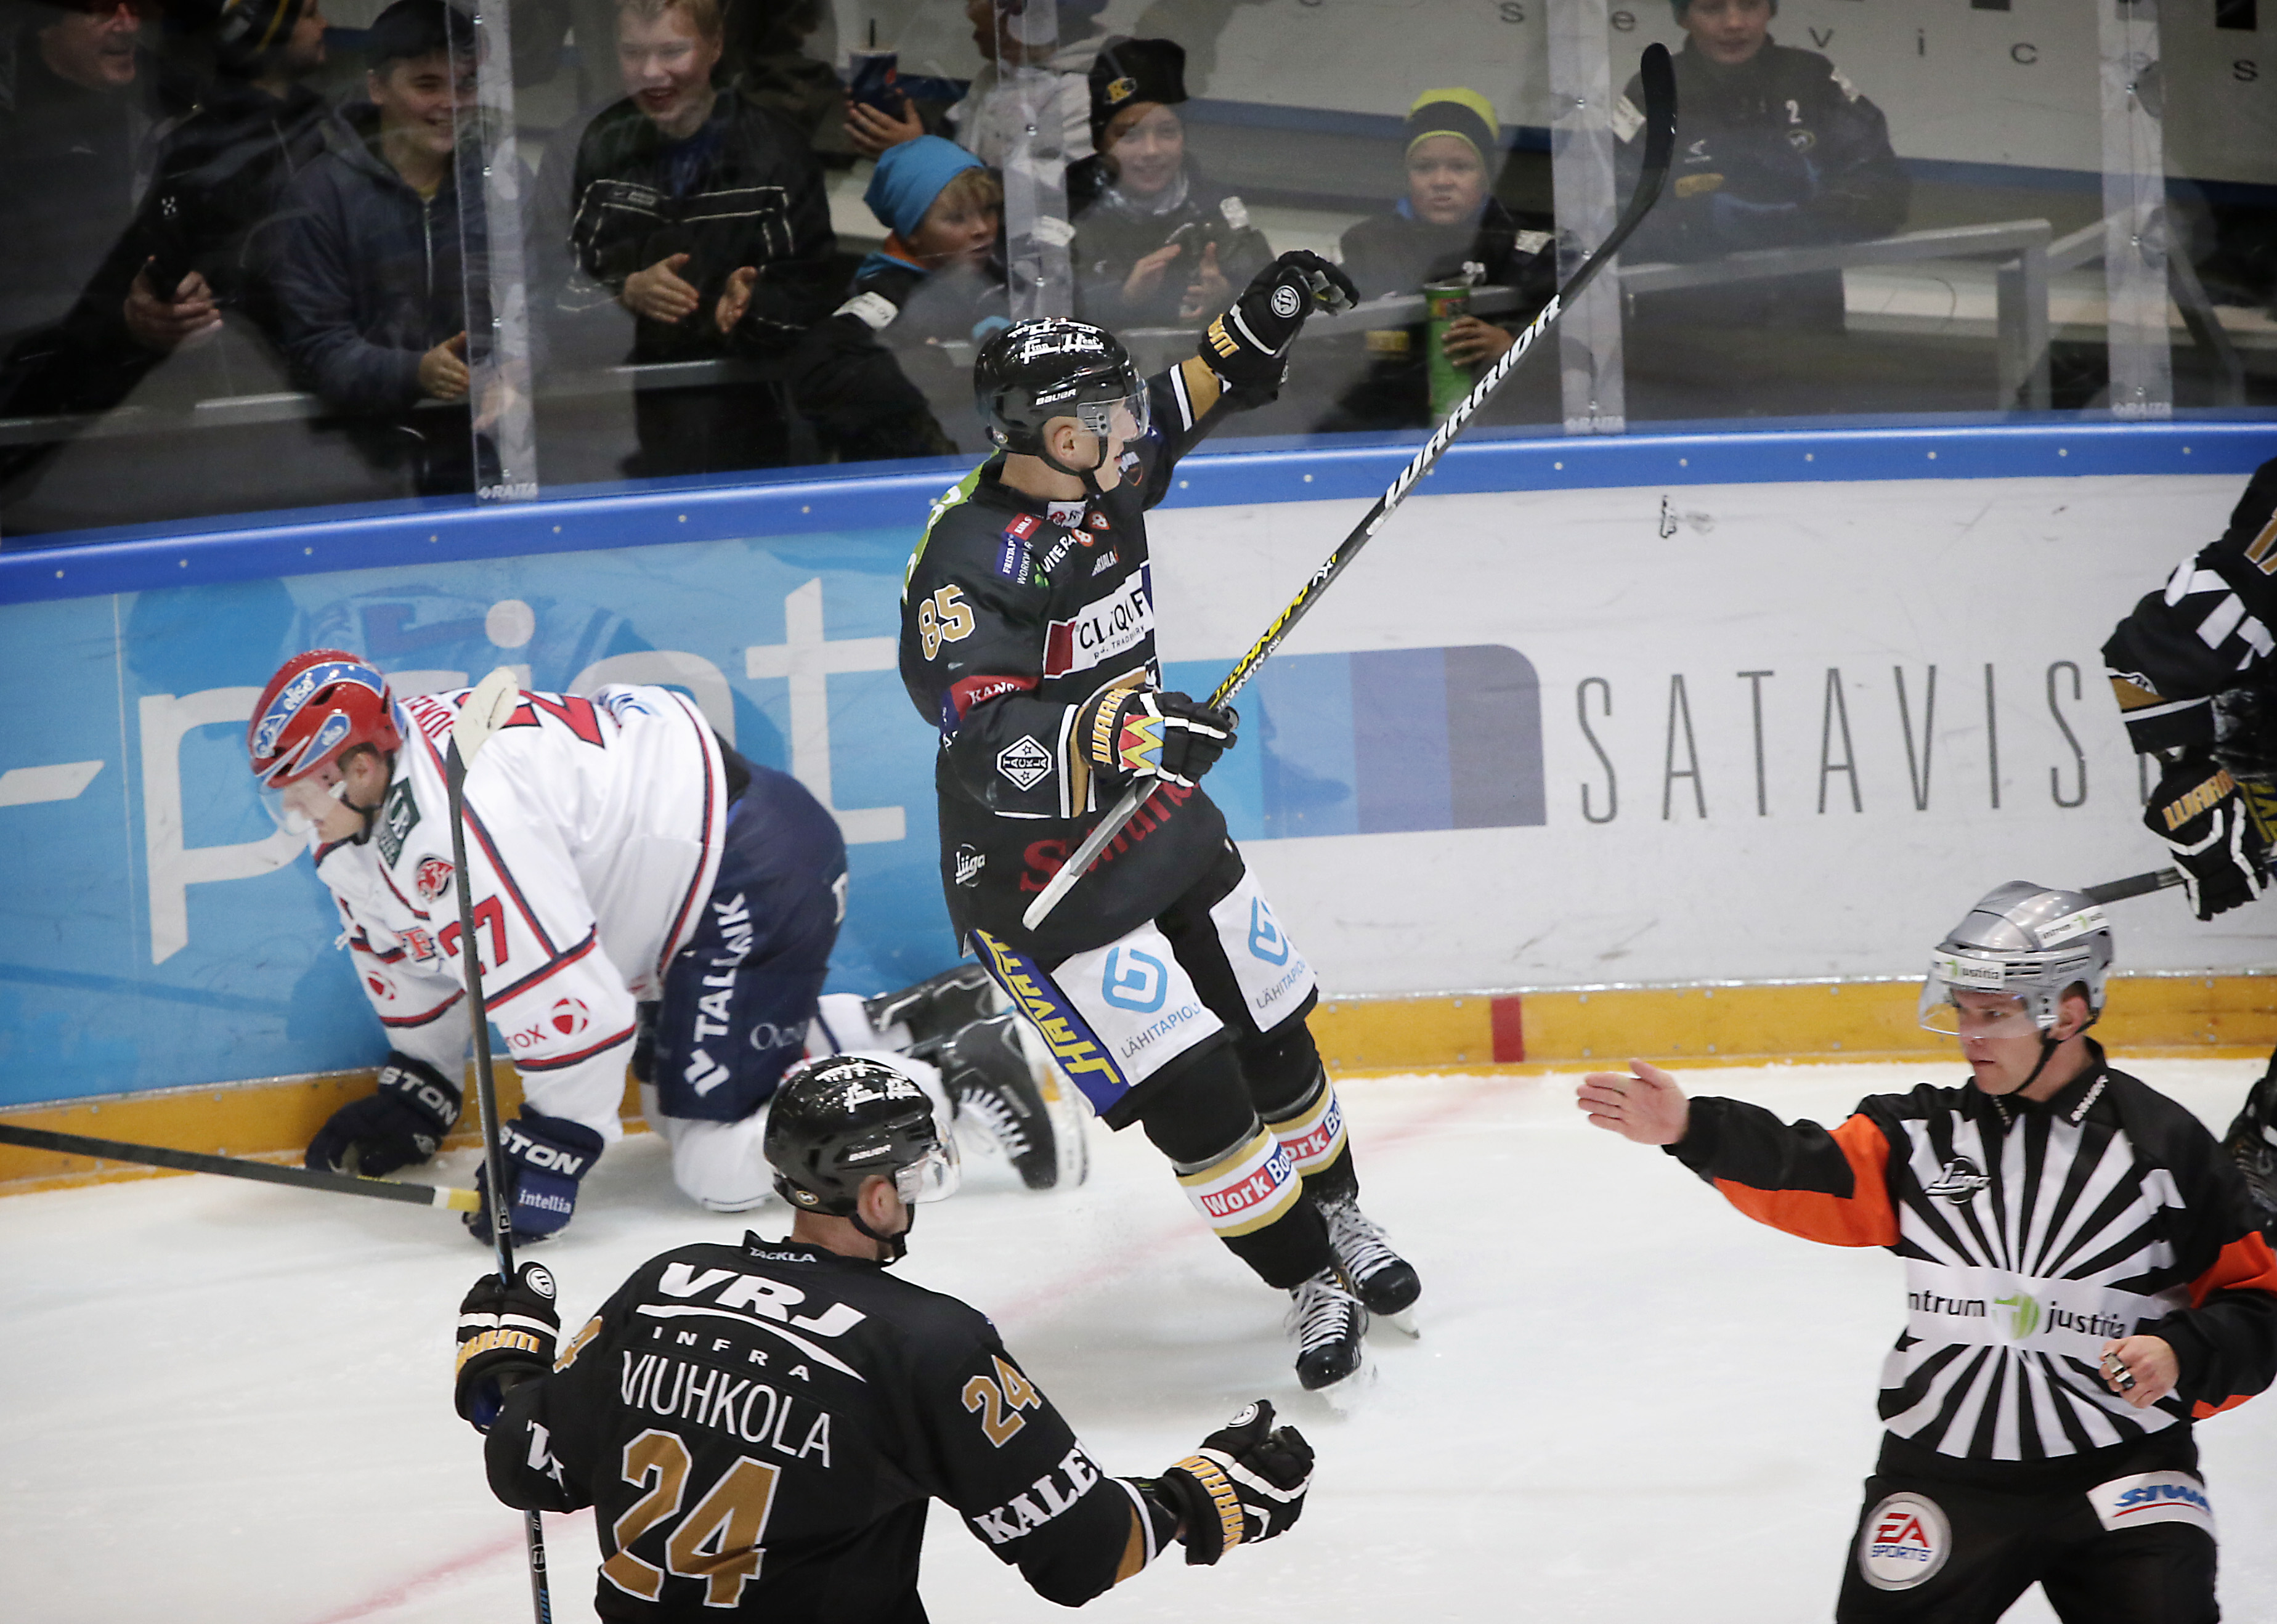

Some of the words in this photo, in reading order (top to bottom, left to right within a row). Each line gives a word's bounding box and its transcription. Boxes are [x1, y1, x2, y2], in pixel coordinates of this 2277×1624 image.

[1035, 388, 1077, 406] BAUER
[1384, 293, 1561, 510] WARRIOR
[919, 584, 975, 661] 85
[283, 672, 315, 710] elisa
[1002, 756, 1047, 768] TACKLA
[519, 1189, 572, 1214] intellia
[749, 1246, 817, 1263] TACKLA
[659, 1262, 867, 1337] VRJ
[653, 1326, 811, 1382] INFRA
[621, 1350, 830, 1468] VIUHKOLA
[961, 1354, 1041, 1448] 24
[601, 1427, 781, 1608] 24
[1875, 1512, 1928, 1548] EA
[1871, 1545, 1933, 1562] SPORTS
